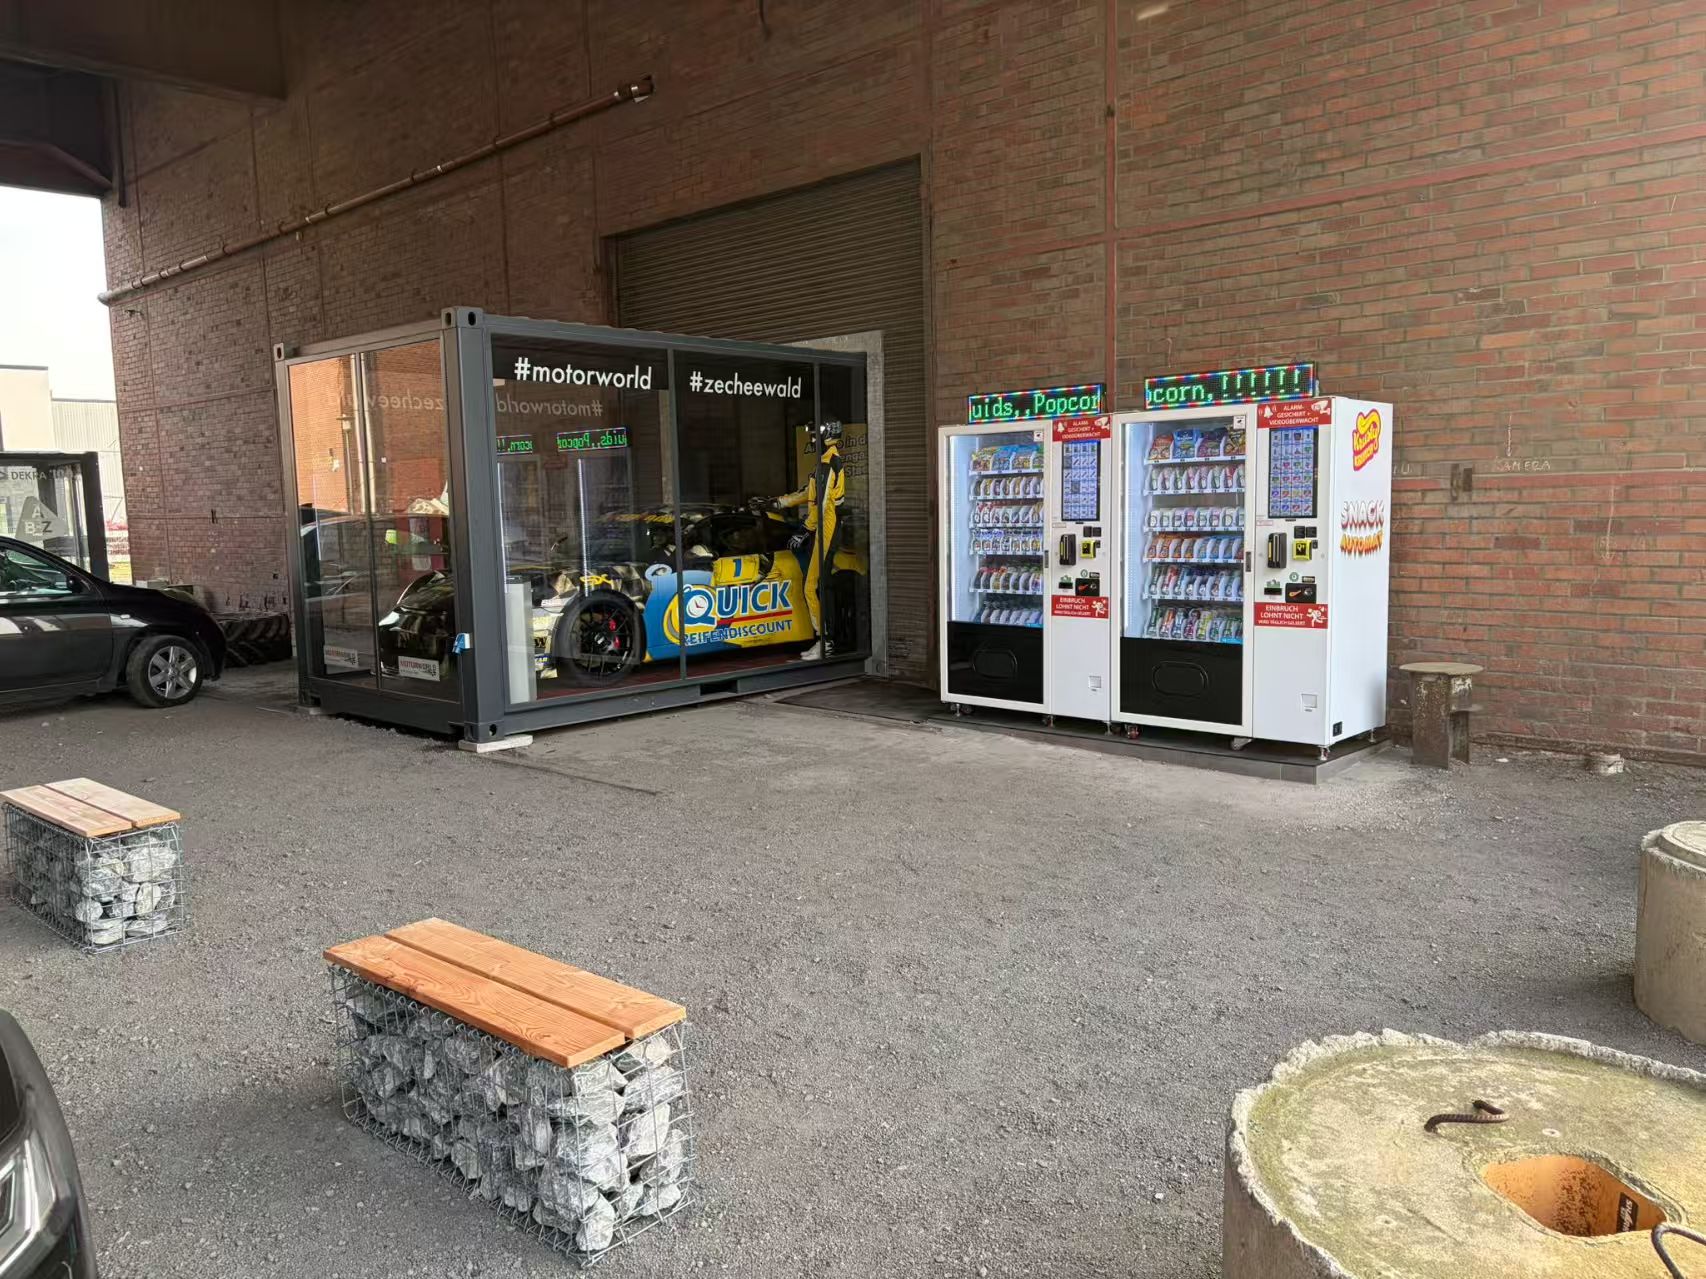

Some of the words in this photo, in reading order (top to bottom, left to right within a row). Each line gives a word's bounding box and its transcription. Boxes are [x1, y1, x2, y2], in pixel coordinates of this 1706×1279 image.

[514, 356, 652, 390] #motorworld
[690, 371, 802, 398] #zecheewald
[11, 470, 47, 481] DEKRA
[1341, 500, 1385, 530] SNACK
[1341, 529, 1384, 557] AUTOMAT
[683, 579, 793, 628] QUICK
[1265, 604, 1299, 612] EINBRUCH
[684, 618, 793, 647] REIFENDISCOUNT
